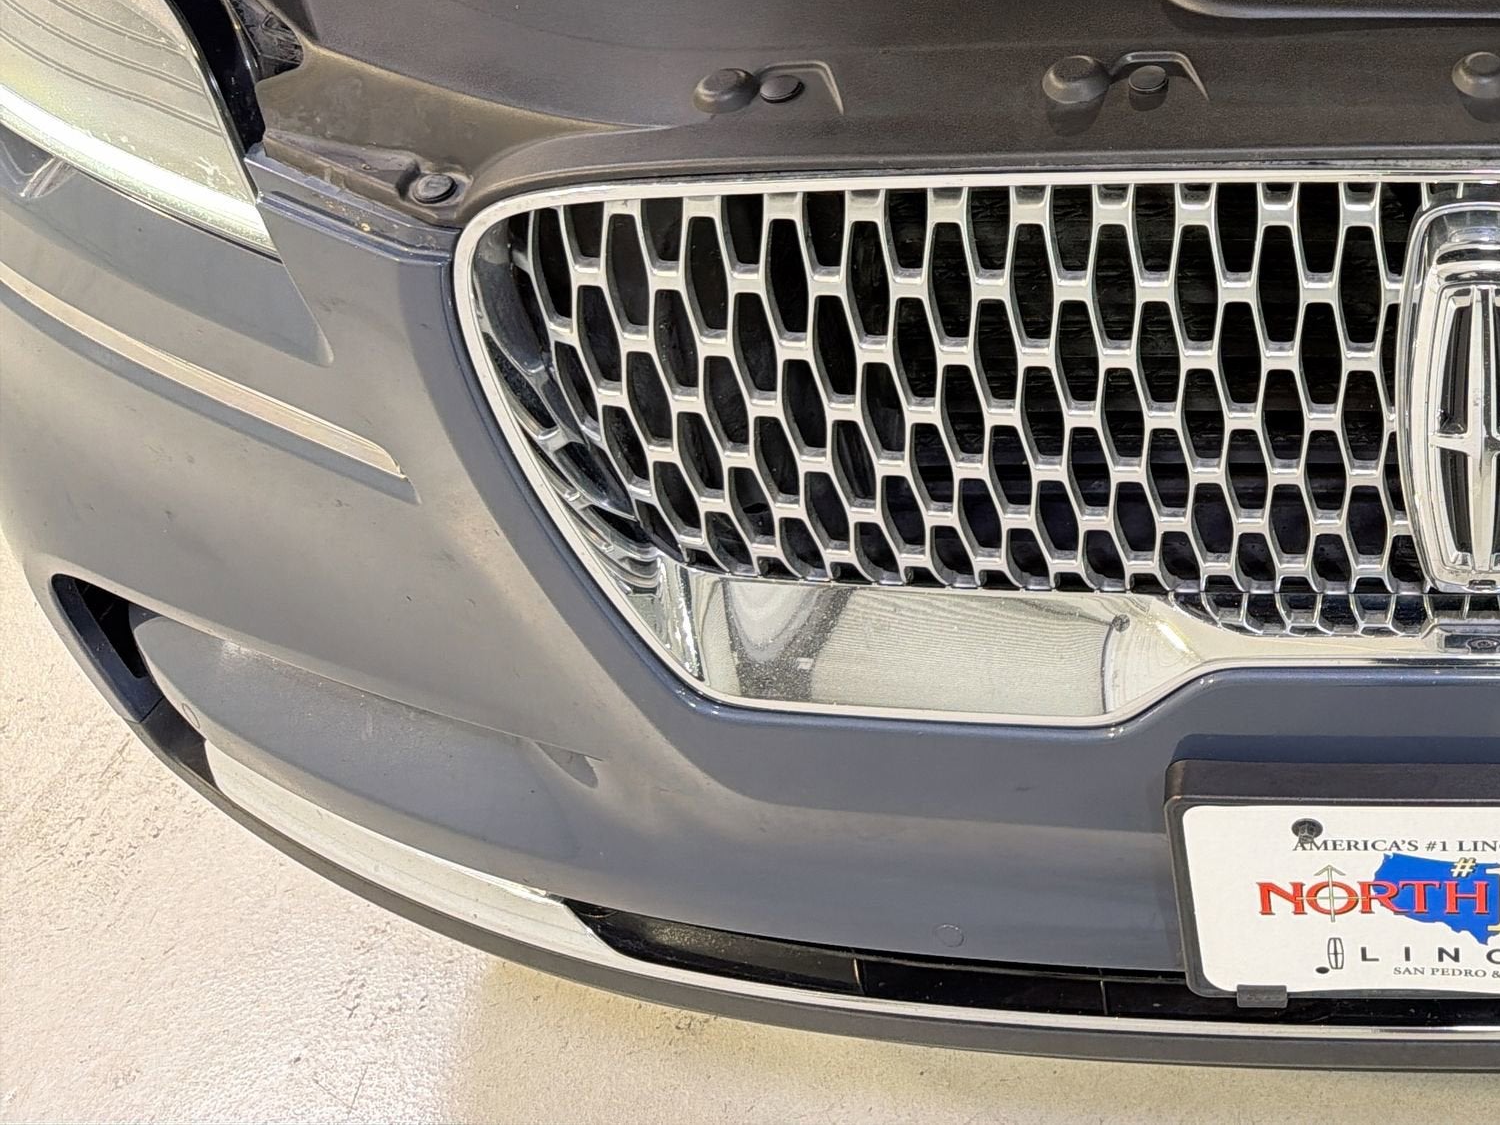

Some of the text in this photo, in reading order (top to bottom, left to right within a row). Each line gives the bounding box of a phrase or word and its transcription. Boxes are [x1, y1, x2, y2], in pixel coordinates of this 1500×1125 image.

[1292, 839, 1419, 852] AMERICA'S
[1424, 840, 1449, 852] #1
[1256, 880, 1491, 916] NORTH
[1393, 966, 1425, 976] SAN
[1430, 967, 1487, 978] PEDRO
